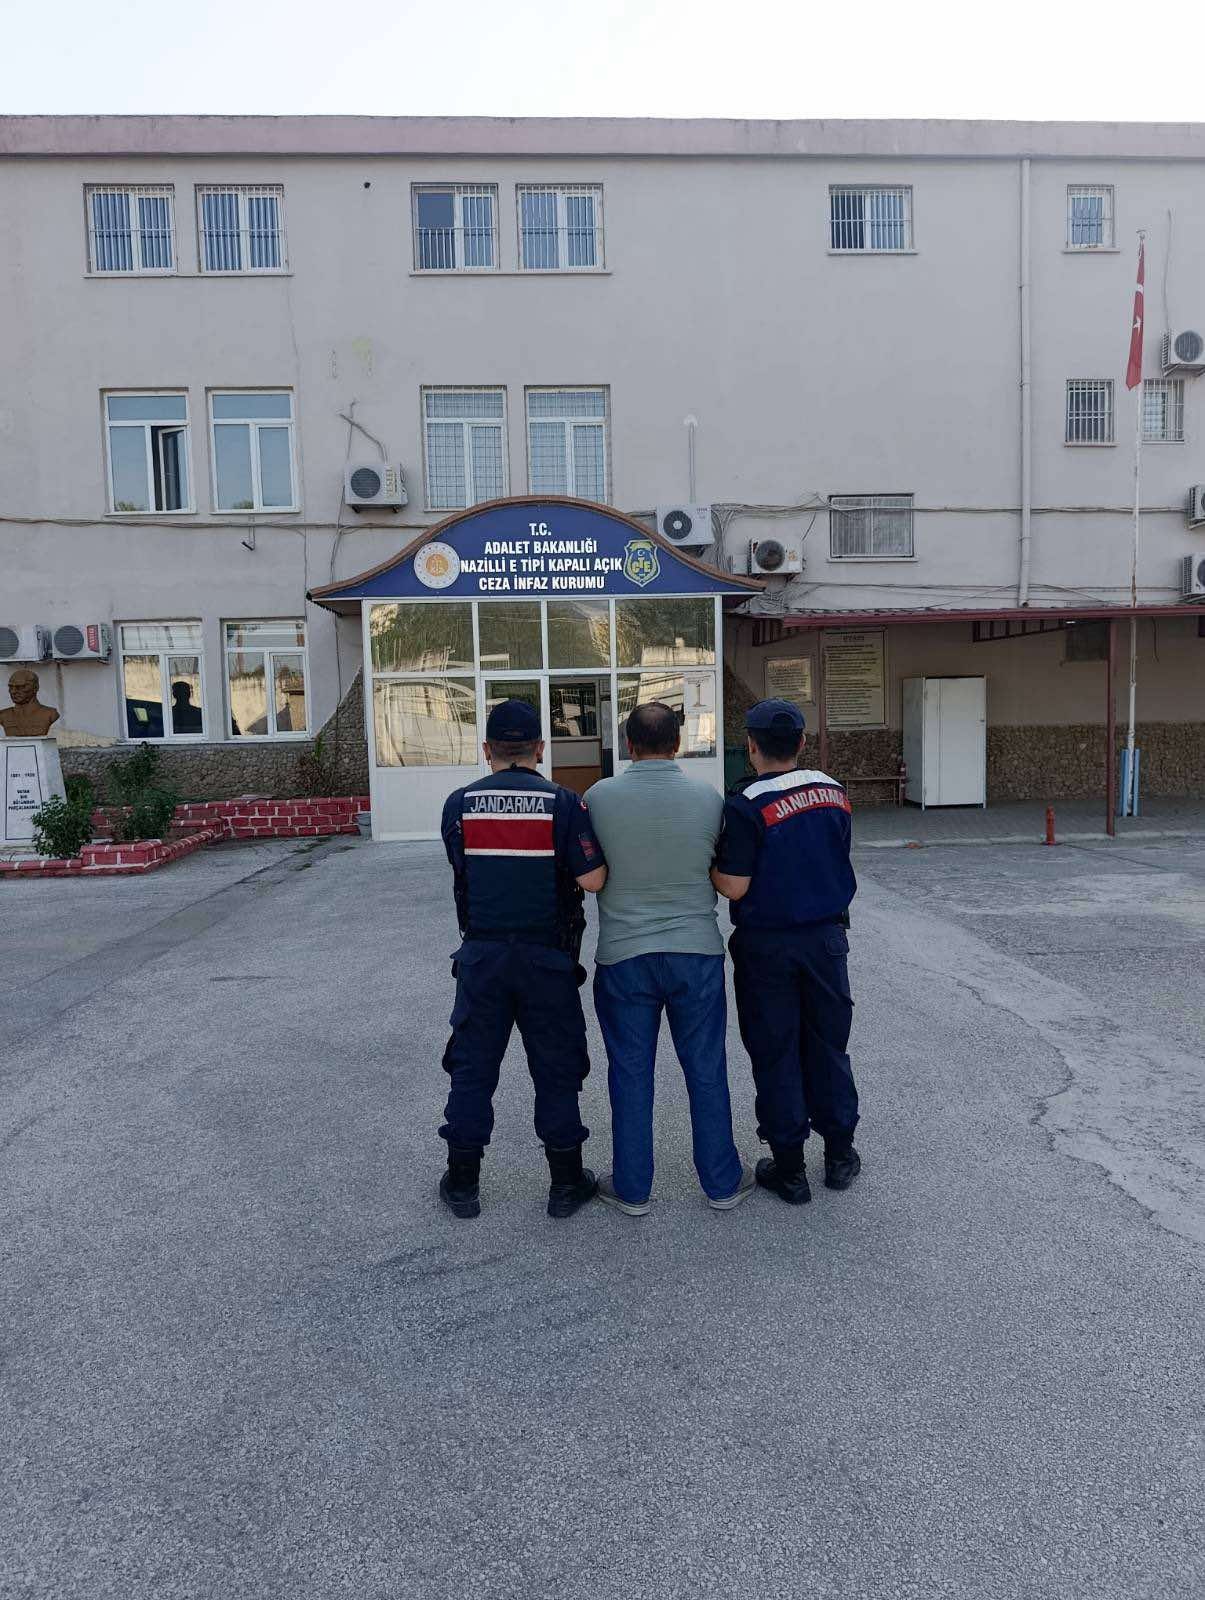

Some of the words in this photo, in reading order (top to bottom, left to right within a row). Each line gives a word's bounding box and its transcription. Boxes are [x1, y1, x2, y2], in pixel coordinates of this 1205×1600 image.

[529, 523, 552, 536] T.C.
[485, 541, 530, 554] ADALET
[533, 537, 597, 554] BAKANLIĞI
[461, 556, 506, 573] NAZİLLİ
[510, 560, 517, 572] E
[521, 556, 545, 572] TİPİ
[549, 559, 590, 572] KAPALI
[594, 558, 623, 574] AÇIK
[479, 578, 511, 590] CEZA
[514, 575, 548, 590] İNFAZ
[552, 577, 605, 590] KURUMU
[470, 796, 545, 813] JANDARMA
